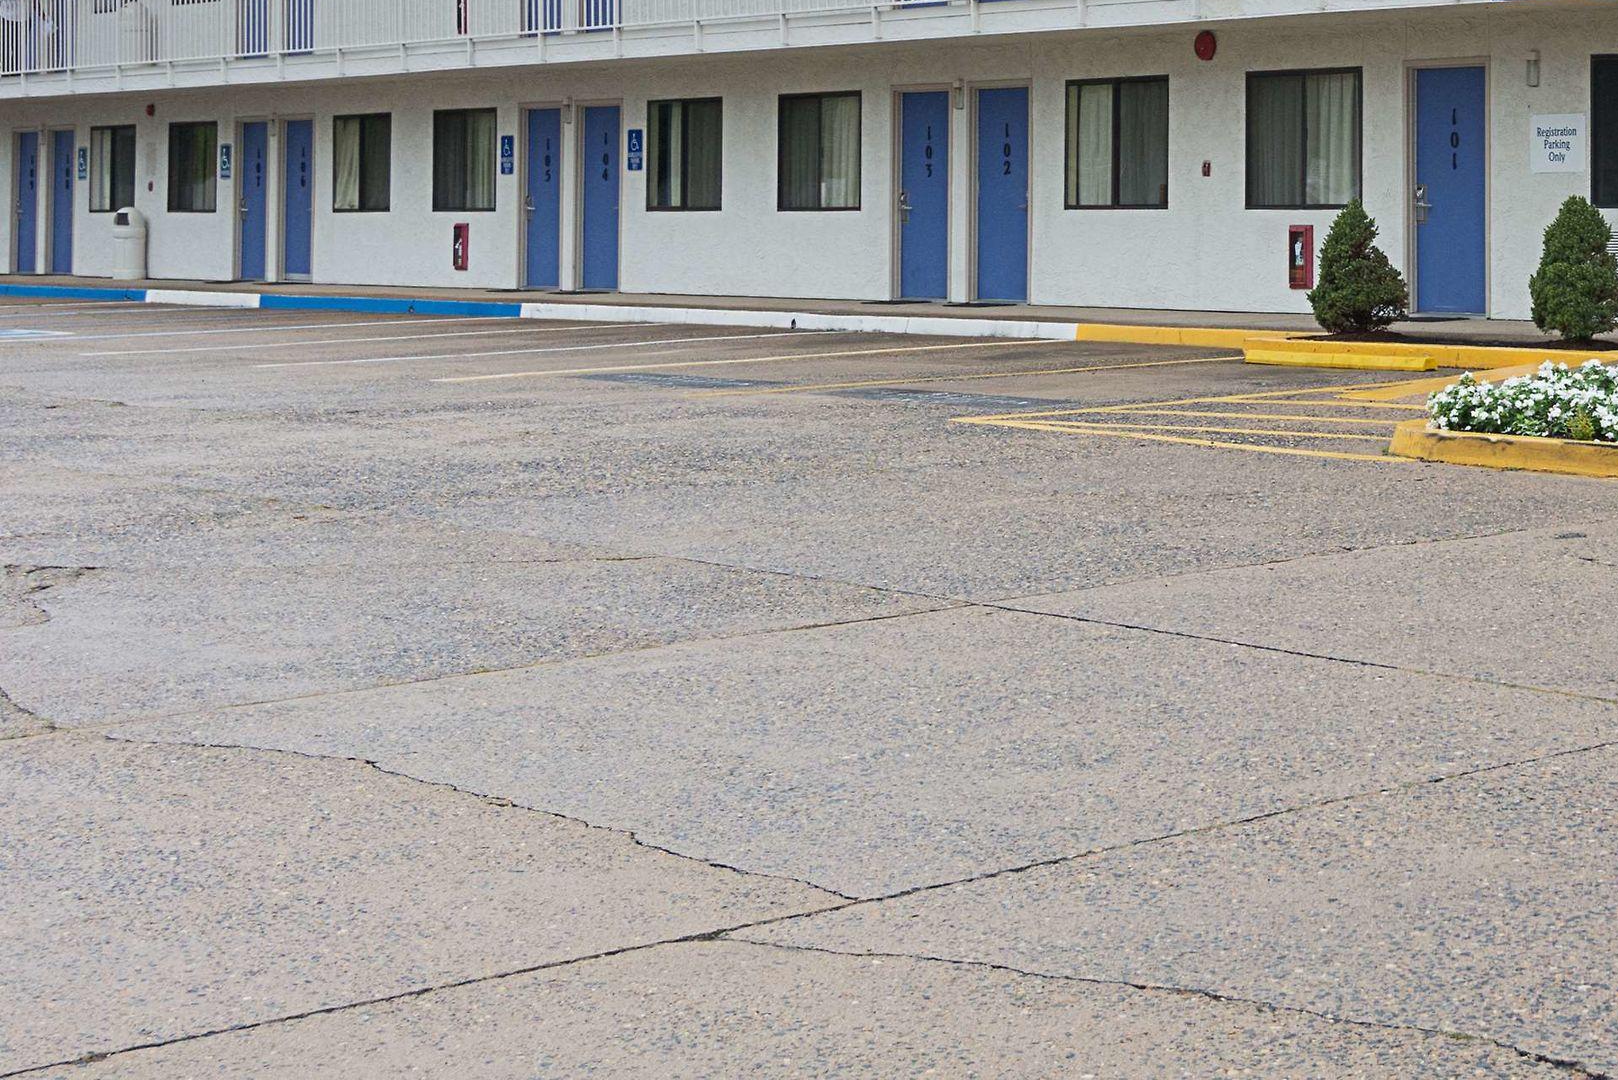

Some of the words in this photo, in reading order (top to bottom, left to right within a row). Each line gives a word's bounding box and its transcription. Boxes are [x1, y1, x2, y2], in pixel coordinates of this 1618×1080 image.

[1450, 108, 1459, 170] 101
[1536, 126, 1577, 139] Registration
[1003, 123, 1011, 175] 102
[1543, 139, 1571, 151] Parking
[1548, 151, 1566, 163] Only
